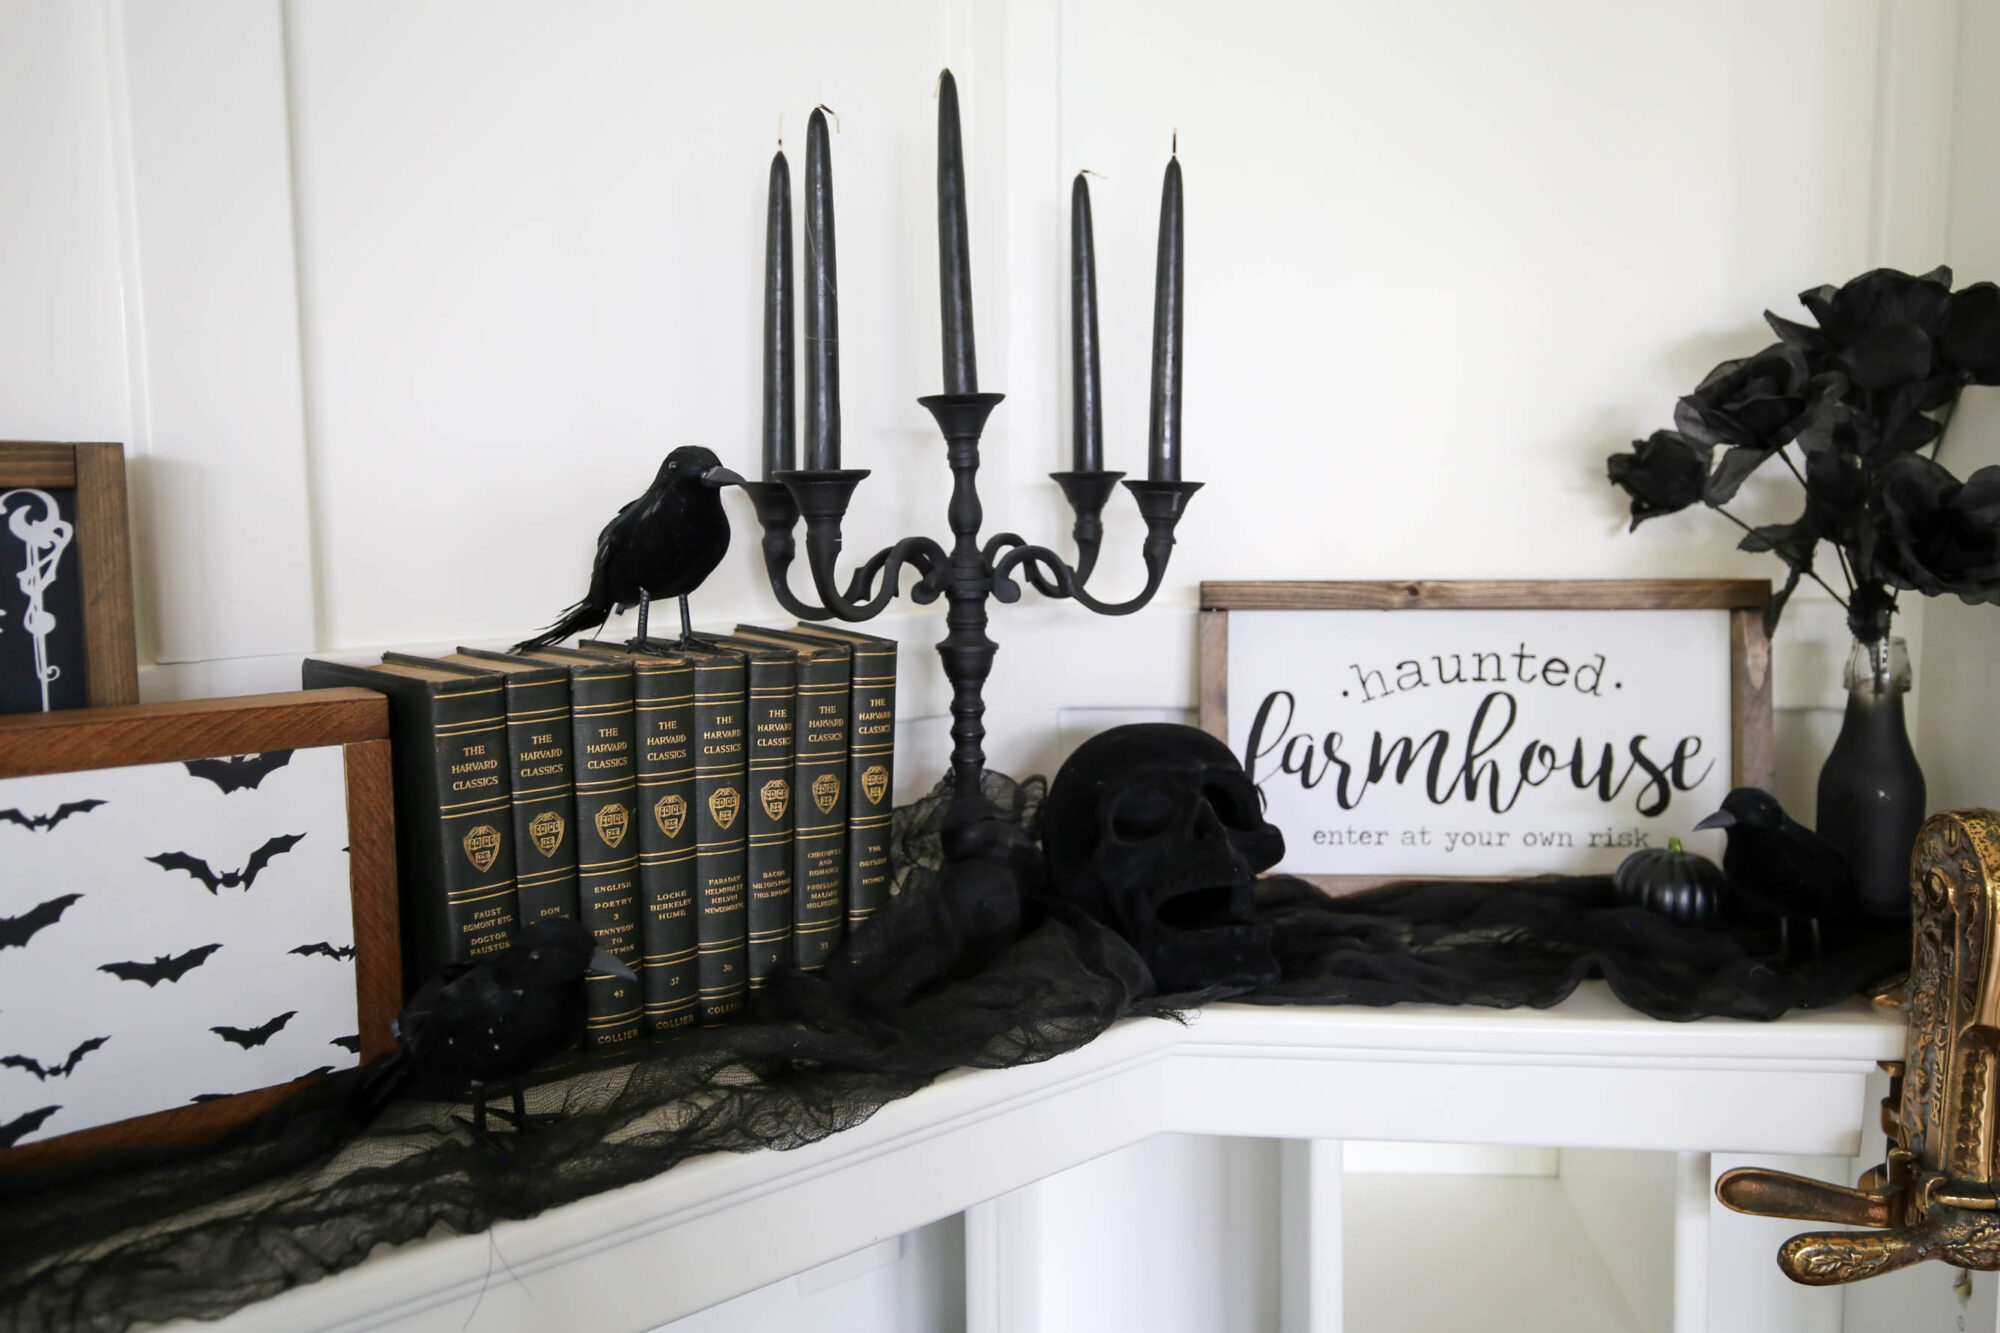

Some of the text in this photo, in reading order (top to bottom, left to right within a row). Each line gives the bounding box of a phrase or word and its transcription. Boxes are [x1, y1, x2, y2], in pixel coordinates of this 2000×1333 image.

[870, 698, 886, 707] THE
[769, 709, 787, 718] THE
[819, 705, 836, 714] THE
[715, 716, 734, 725] THE
[858, 711, 891, 721] HARVARD
[658, 721, 678, 730] THE
[757, 723, 792, 732] HARVARD
[809, 718, 844, 728] HARVARD
[599, 728, 619, 738] THE
[703, 729, 742, 740] HARVARD
[859, 724, 891, 735] CLASSICS
[531, 734, 552, 745] THE
[647, 734, 687, 746] HARVARD
[808, 732, 844, 743] CLASSICS
[463, 745, 485, 756] THE
[587, 741, 627, 754] HARVARD
[703, 743, 742, 754] CLASSICS
[520, 749, 563, 762] HARVARD
[647, 749, 687, 761] CLASSICS
[452, 760, 498, 774] HARVARD
[587, 757, 628, 770] CLASSICS
[521, 764, 563, 777] CLASSICS
[453, 776, 499, 791] CLASSICS
[1313, 827, 1389, 847] enter
[1401, 829, 1433, 847] at
[1445, 831, 1510, 853] your
[1524, 831, 1574, 847] own
[762, 869, 785, 879] BACON
[708, 874, 741, 886] FARADAY
[594, 882, 632, 894] ENGLISH
[656, 890, 687, 901] LOCKE
[594, 897, 633, 910] POETRY
[650, 898, 692, 912] BERKELEY
[474, 907, 502, 920] FAUST
[540, 906, 560, 917] DON
[658, 909, 686, 920] HUME
[463, 915, 514, 932] EGMONT ETC.
[593, 923, 634, 936] TENNYSON
[471, 932, 508, 946] DOCTOR
[612, 937, 623, 945] TO
[470, 941, 511, 956] FAUSTUS
[669, 976, 680, 986] 37
[613, 989, 624, 998] 42
[655, 1014, 694, 1029] COLLIER
[598, 1029, 639, 1044] COLLIER
